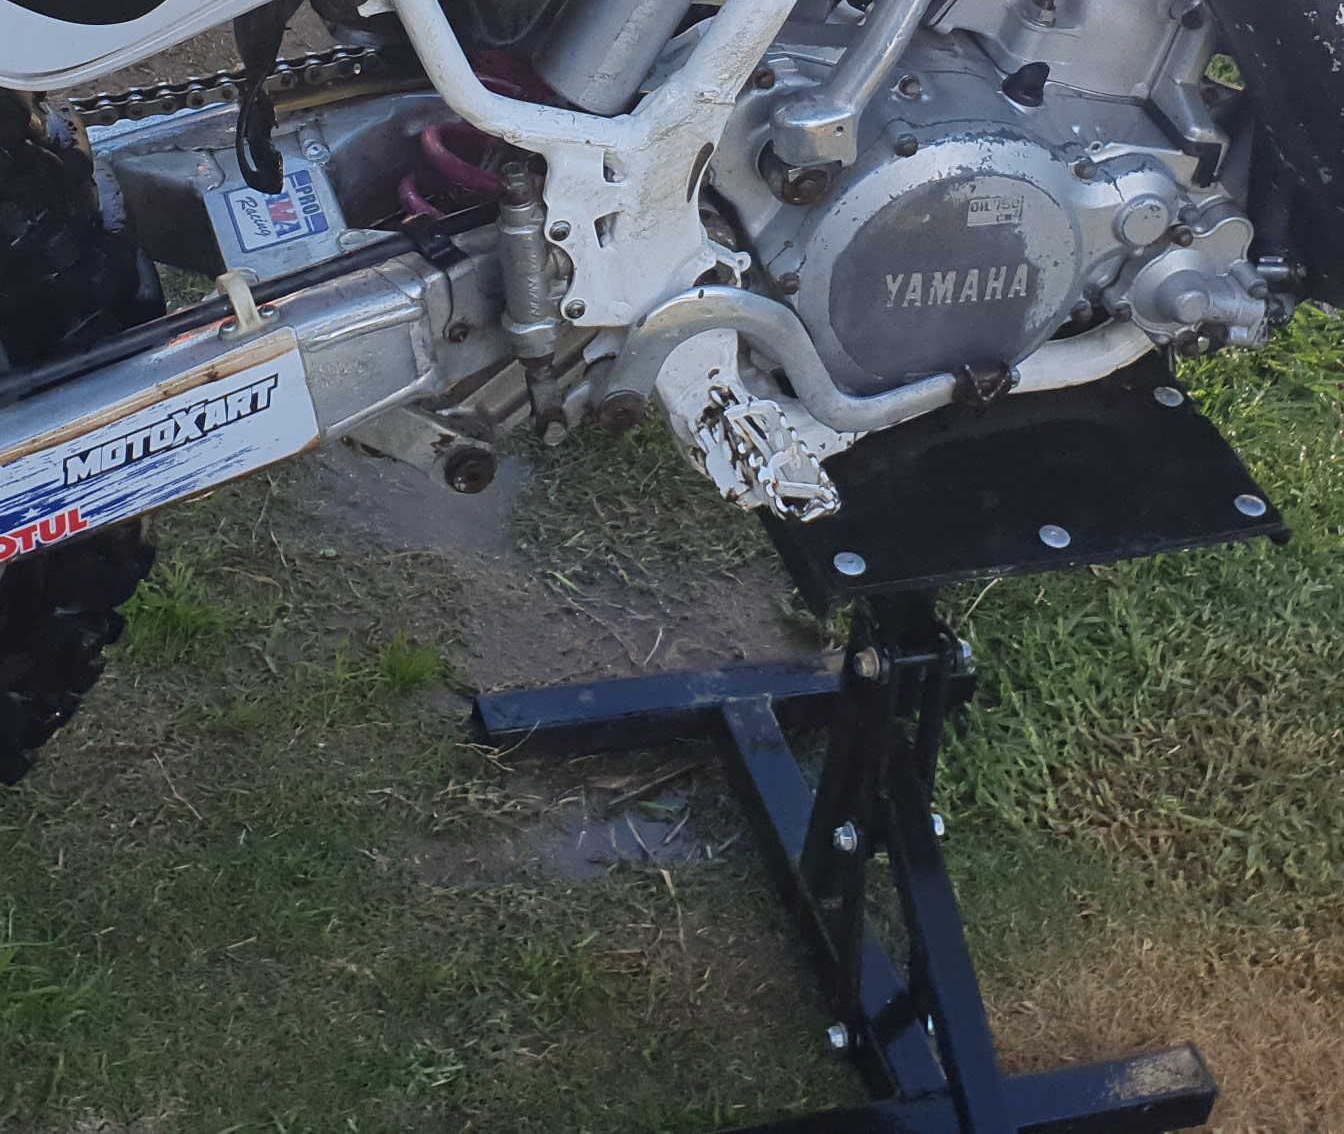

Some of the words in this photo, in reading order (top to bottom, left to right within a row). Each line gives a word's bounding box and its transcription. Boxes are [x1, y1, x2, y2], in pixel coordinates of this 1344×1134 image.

[235, 195, 272, 238] Racing
[295, 183, 321, 215] PRO
[970, 200, 992, 213] OIL
[885, 264, 1028, 308] YAMAHA
[63, 373, 279, 486] MOTOXART
